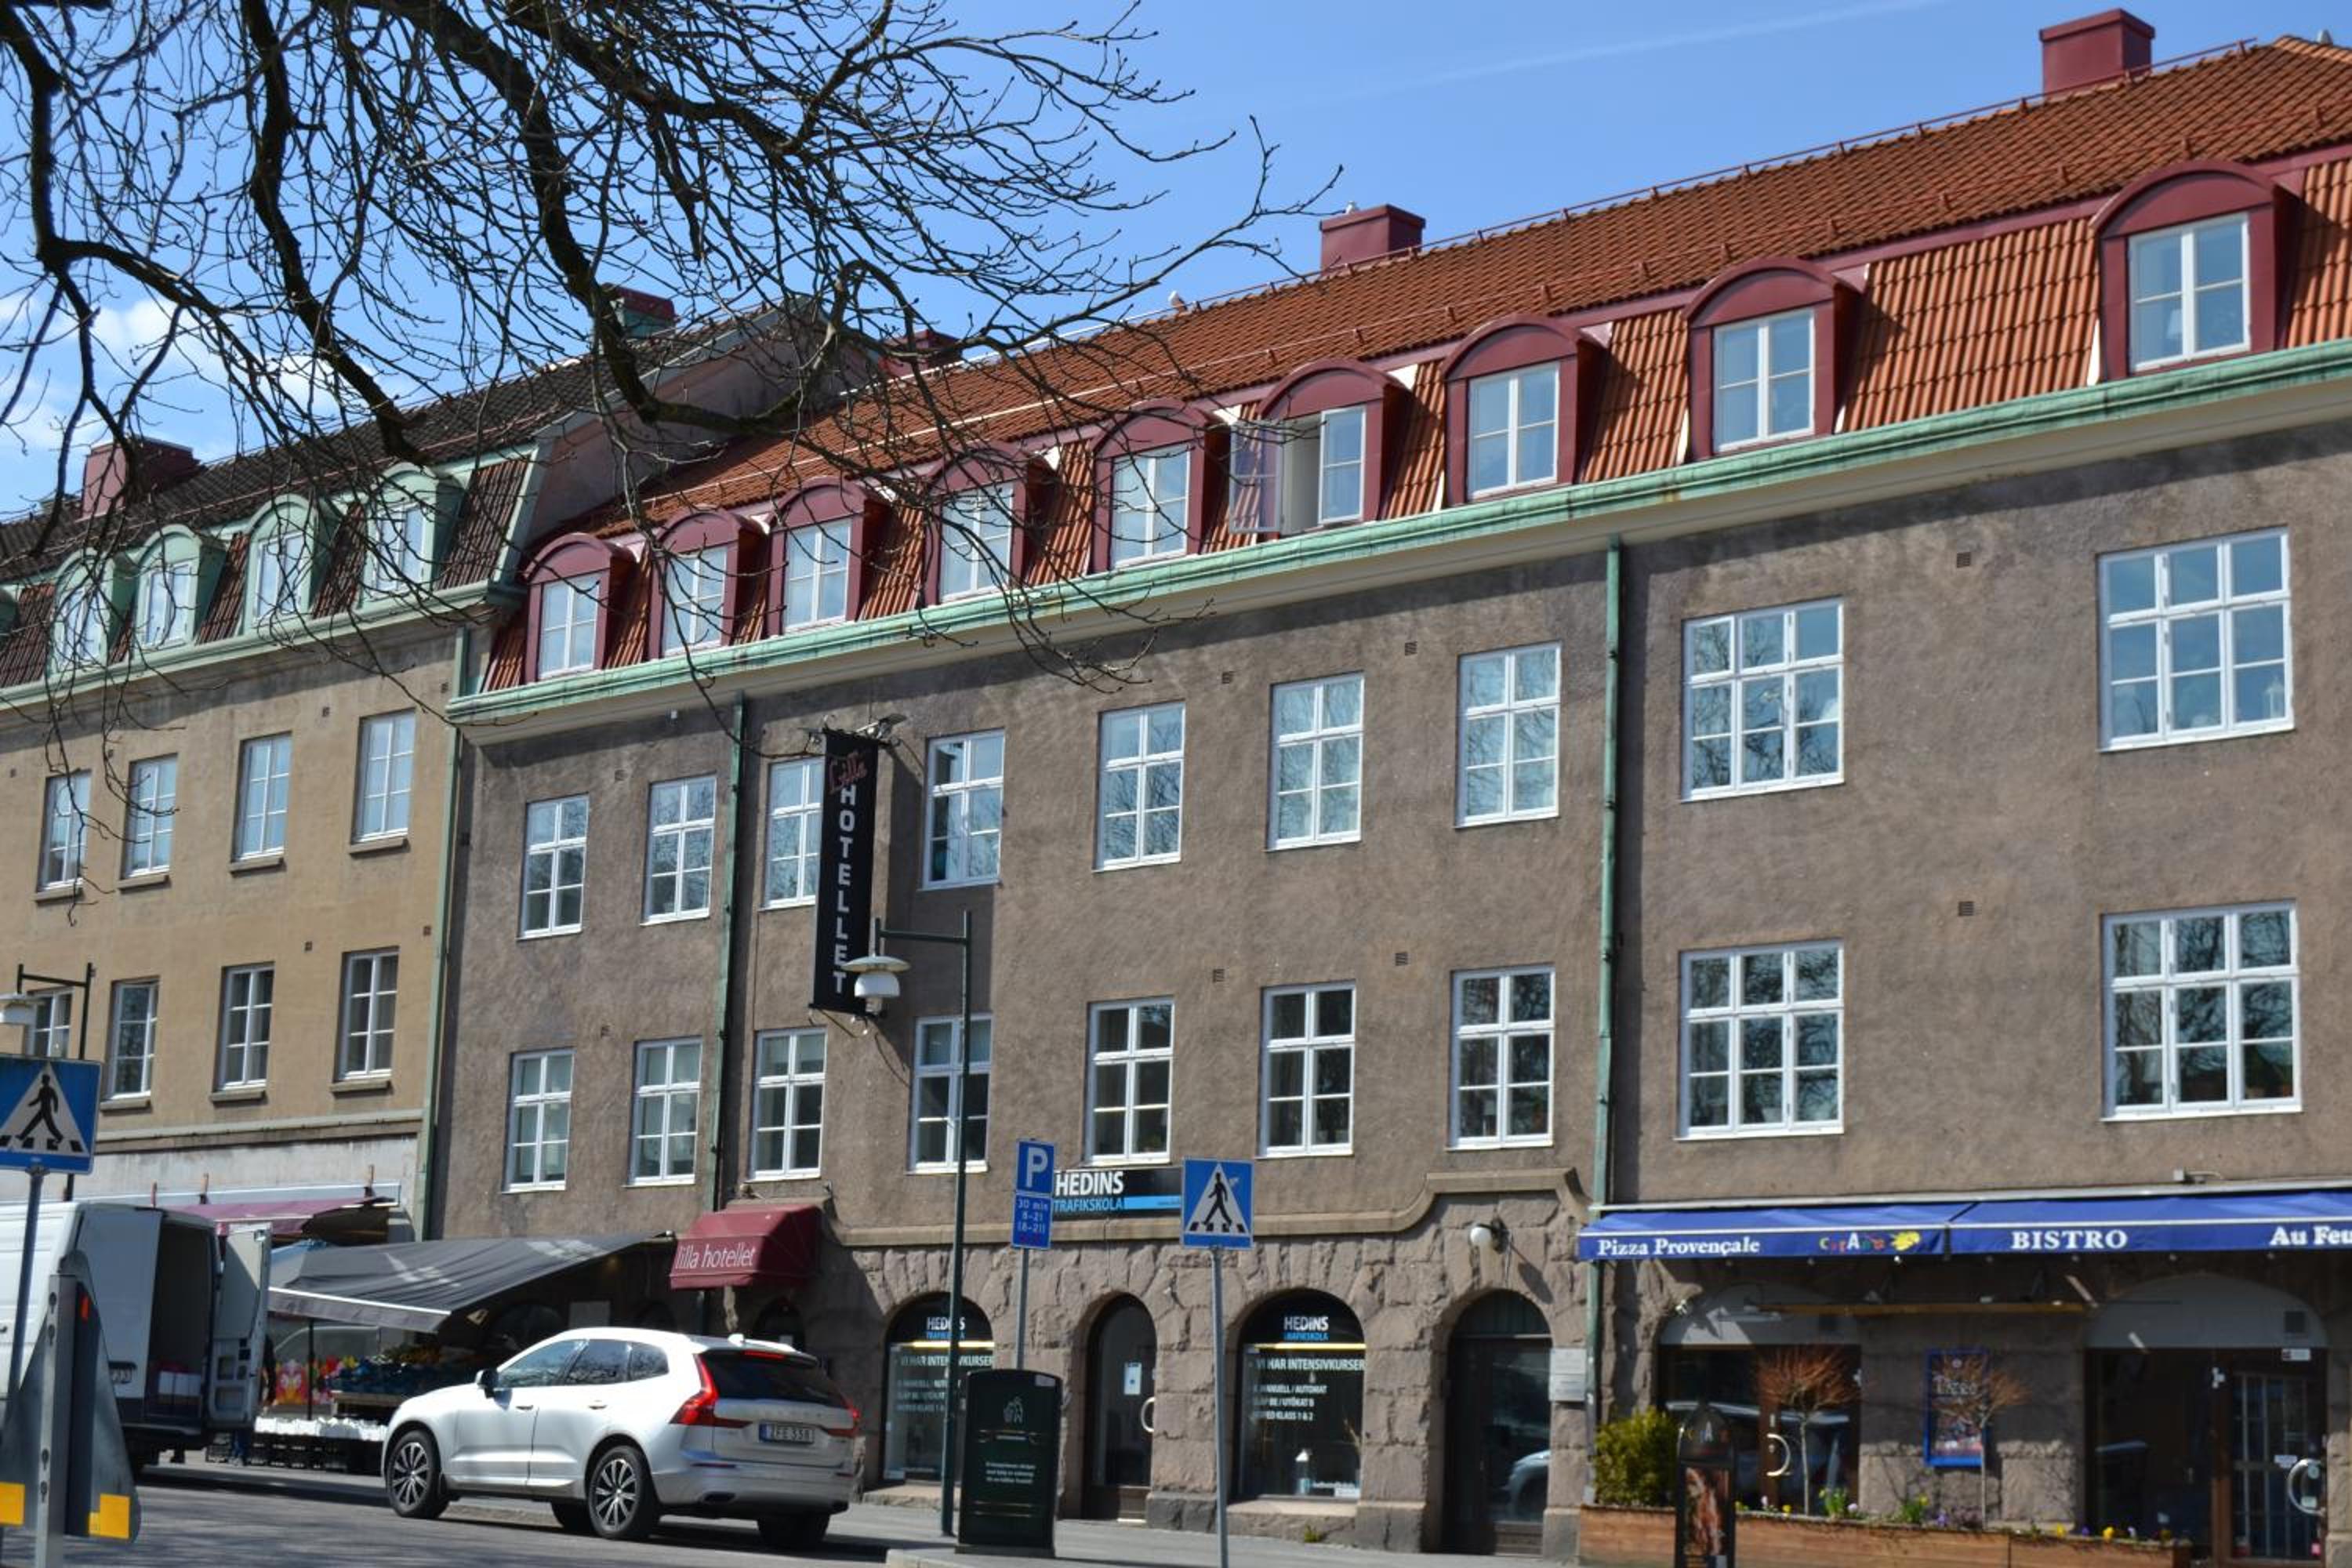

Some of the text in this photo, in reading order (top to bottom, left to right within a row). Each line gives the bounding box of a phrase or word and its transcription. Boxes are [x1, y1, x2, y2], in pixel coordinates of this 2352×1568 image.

[833, 784, 857, 994] HOTELLET
[1025, 1147, 1048, 1189] P
[1054, 1171, 1124, 1196] HEDINS
[1054, 1199, 1122, 1213] TRAFIKSKOLA
[2011, 1229, 2128, 1249] BISTRO
[2269, 1225, 2307, 1246] Au
[675, 1242, 756, 1269] lilla hotellet
[1597, 1236, 1760, 1257] Pizza Provençale
[1284, 1316, 1329, 1330] HEDINS
[1267, 1358, 1287, 1370] HAR
